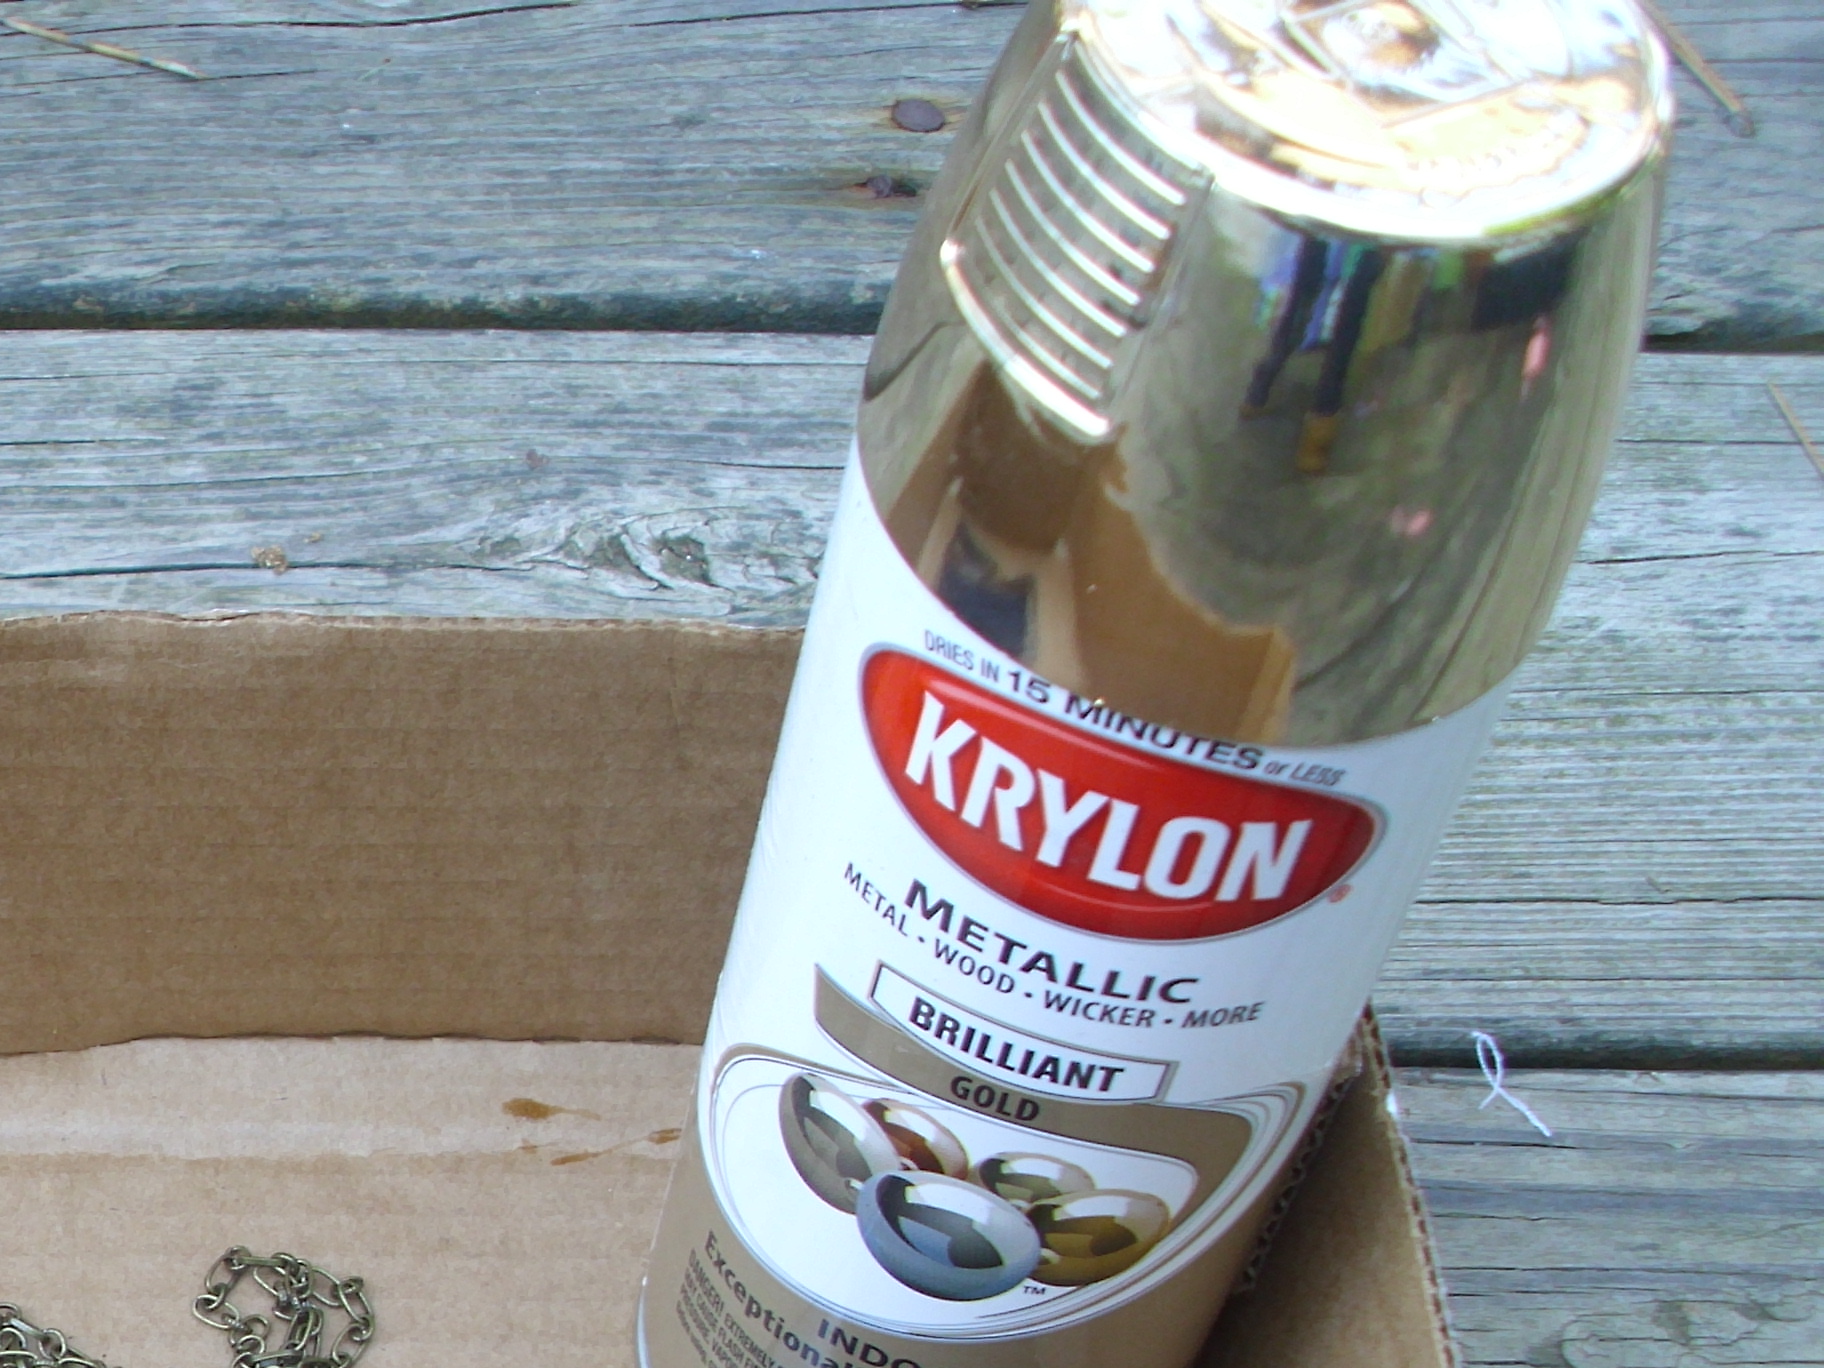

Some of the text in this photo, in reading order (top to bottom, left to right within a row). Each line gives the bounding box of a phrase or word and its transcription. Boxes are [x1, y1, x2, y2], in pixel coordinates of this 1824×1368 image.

[924, 629, 974, 671] DRIES
[980, 658, 1000, 682] IN
[1008, 670, 1052, 703] 15
[1064, 690, 1265, 771] MINUTES
[1289, 761, 1346, 786] LESS
[905, 690, 1313, 901] KRYLON
[844, 861, 1267, 1029] METAL WOOD WICKER MORE
[904, 878, 1201, 1004] METALLIC
[908, 996, 1125, 1092] BRILLIANT
[950, 1074, 1040, 1122] GOLD
